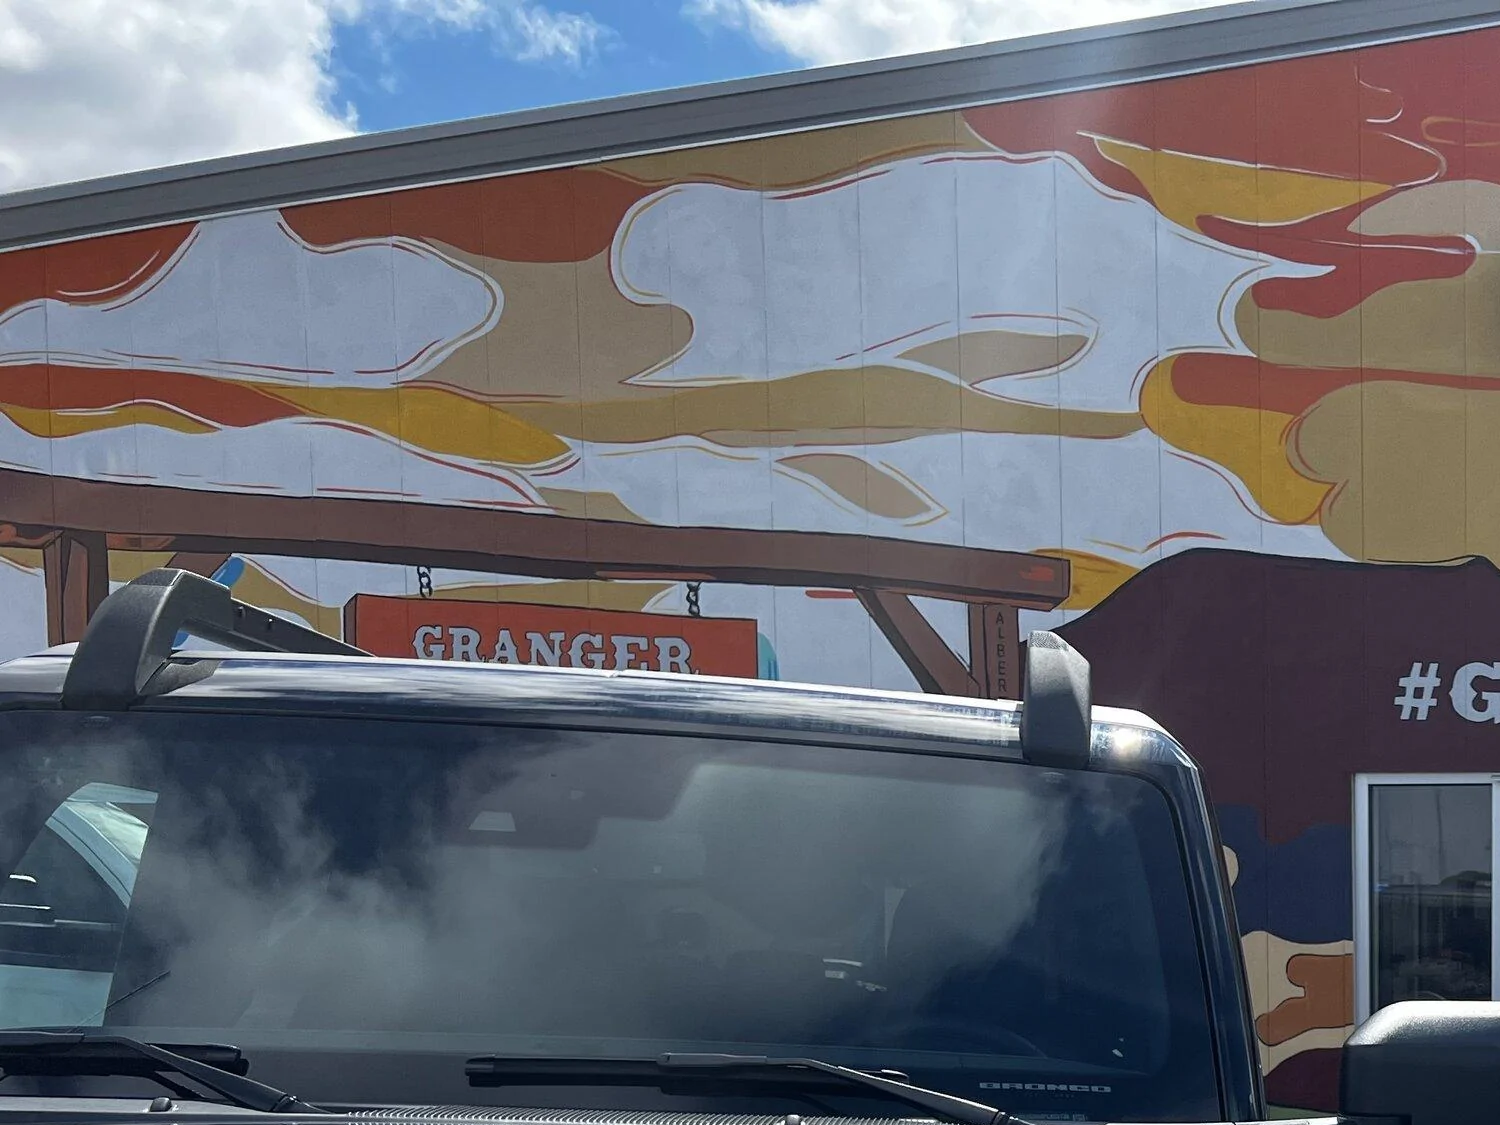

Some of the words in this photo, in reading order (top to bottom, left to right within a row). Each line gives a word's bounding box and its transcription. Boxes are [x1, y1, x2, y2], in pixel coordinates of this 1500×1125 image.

[412, 625, 699, 675] GRANGER
[996, 611, 1007, 693] ALBER
[979, 1082, 1112, 1093] BRONCO
